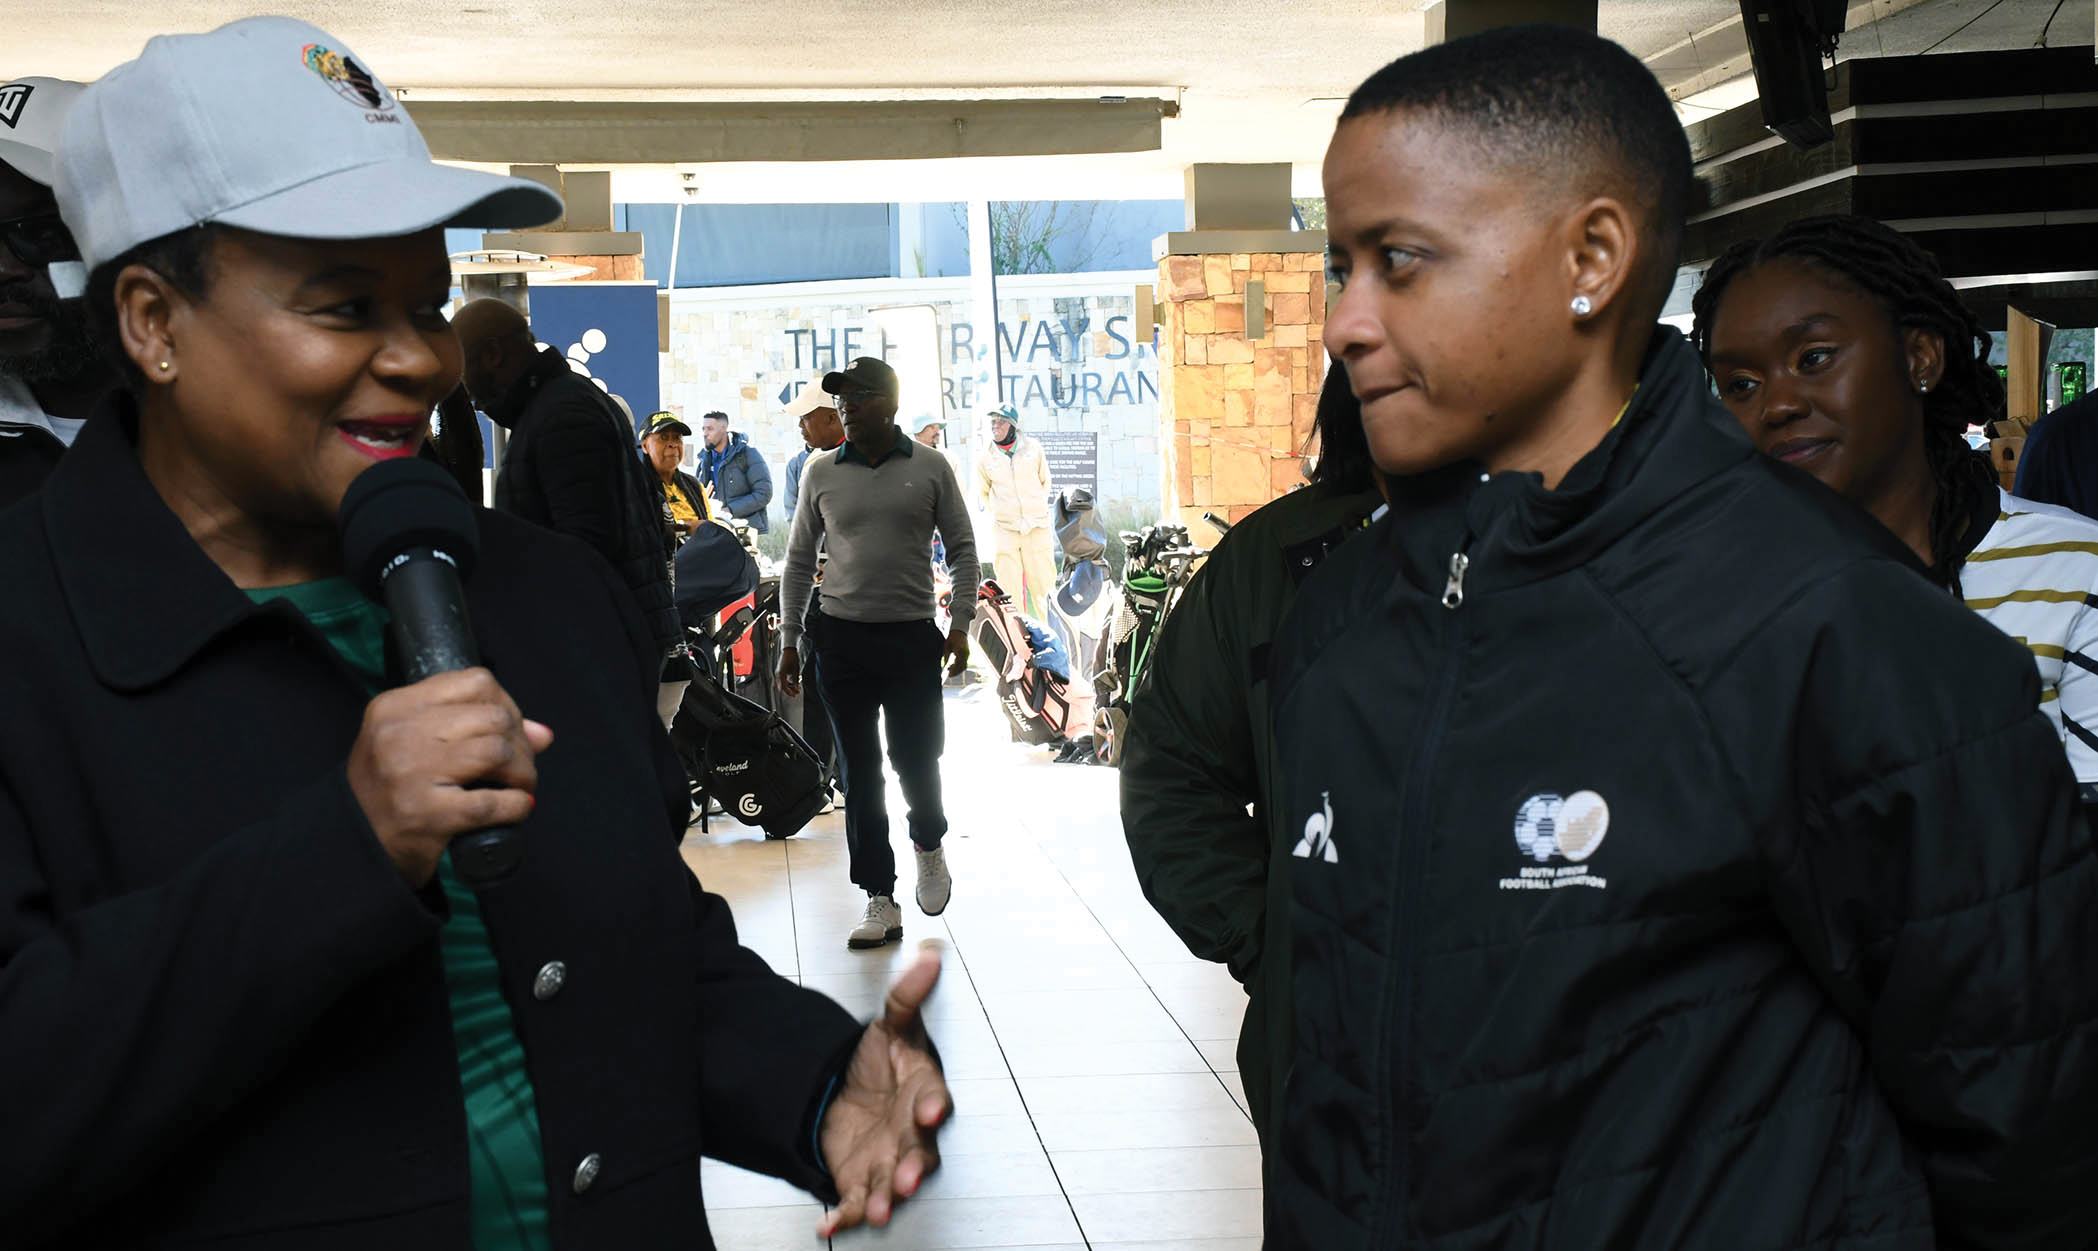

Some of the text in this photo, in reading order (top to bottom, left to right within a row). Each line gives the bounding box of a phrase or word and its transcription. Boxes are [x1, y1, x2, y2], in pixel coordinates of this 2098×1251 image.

[784, 327, 863, 369] THE
[941, 370, 1159, 410] RETAURAN
[716, 759, 749, 773] eveland
[1499, 878, 1552, 889] FOOTBALL
